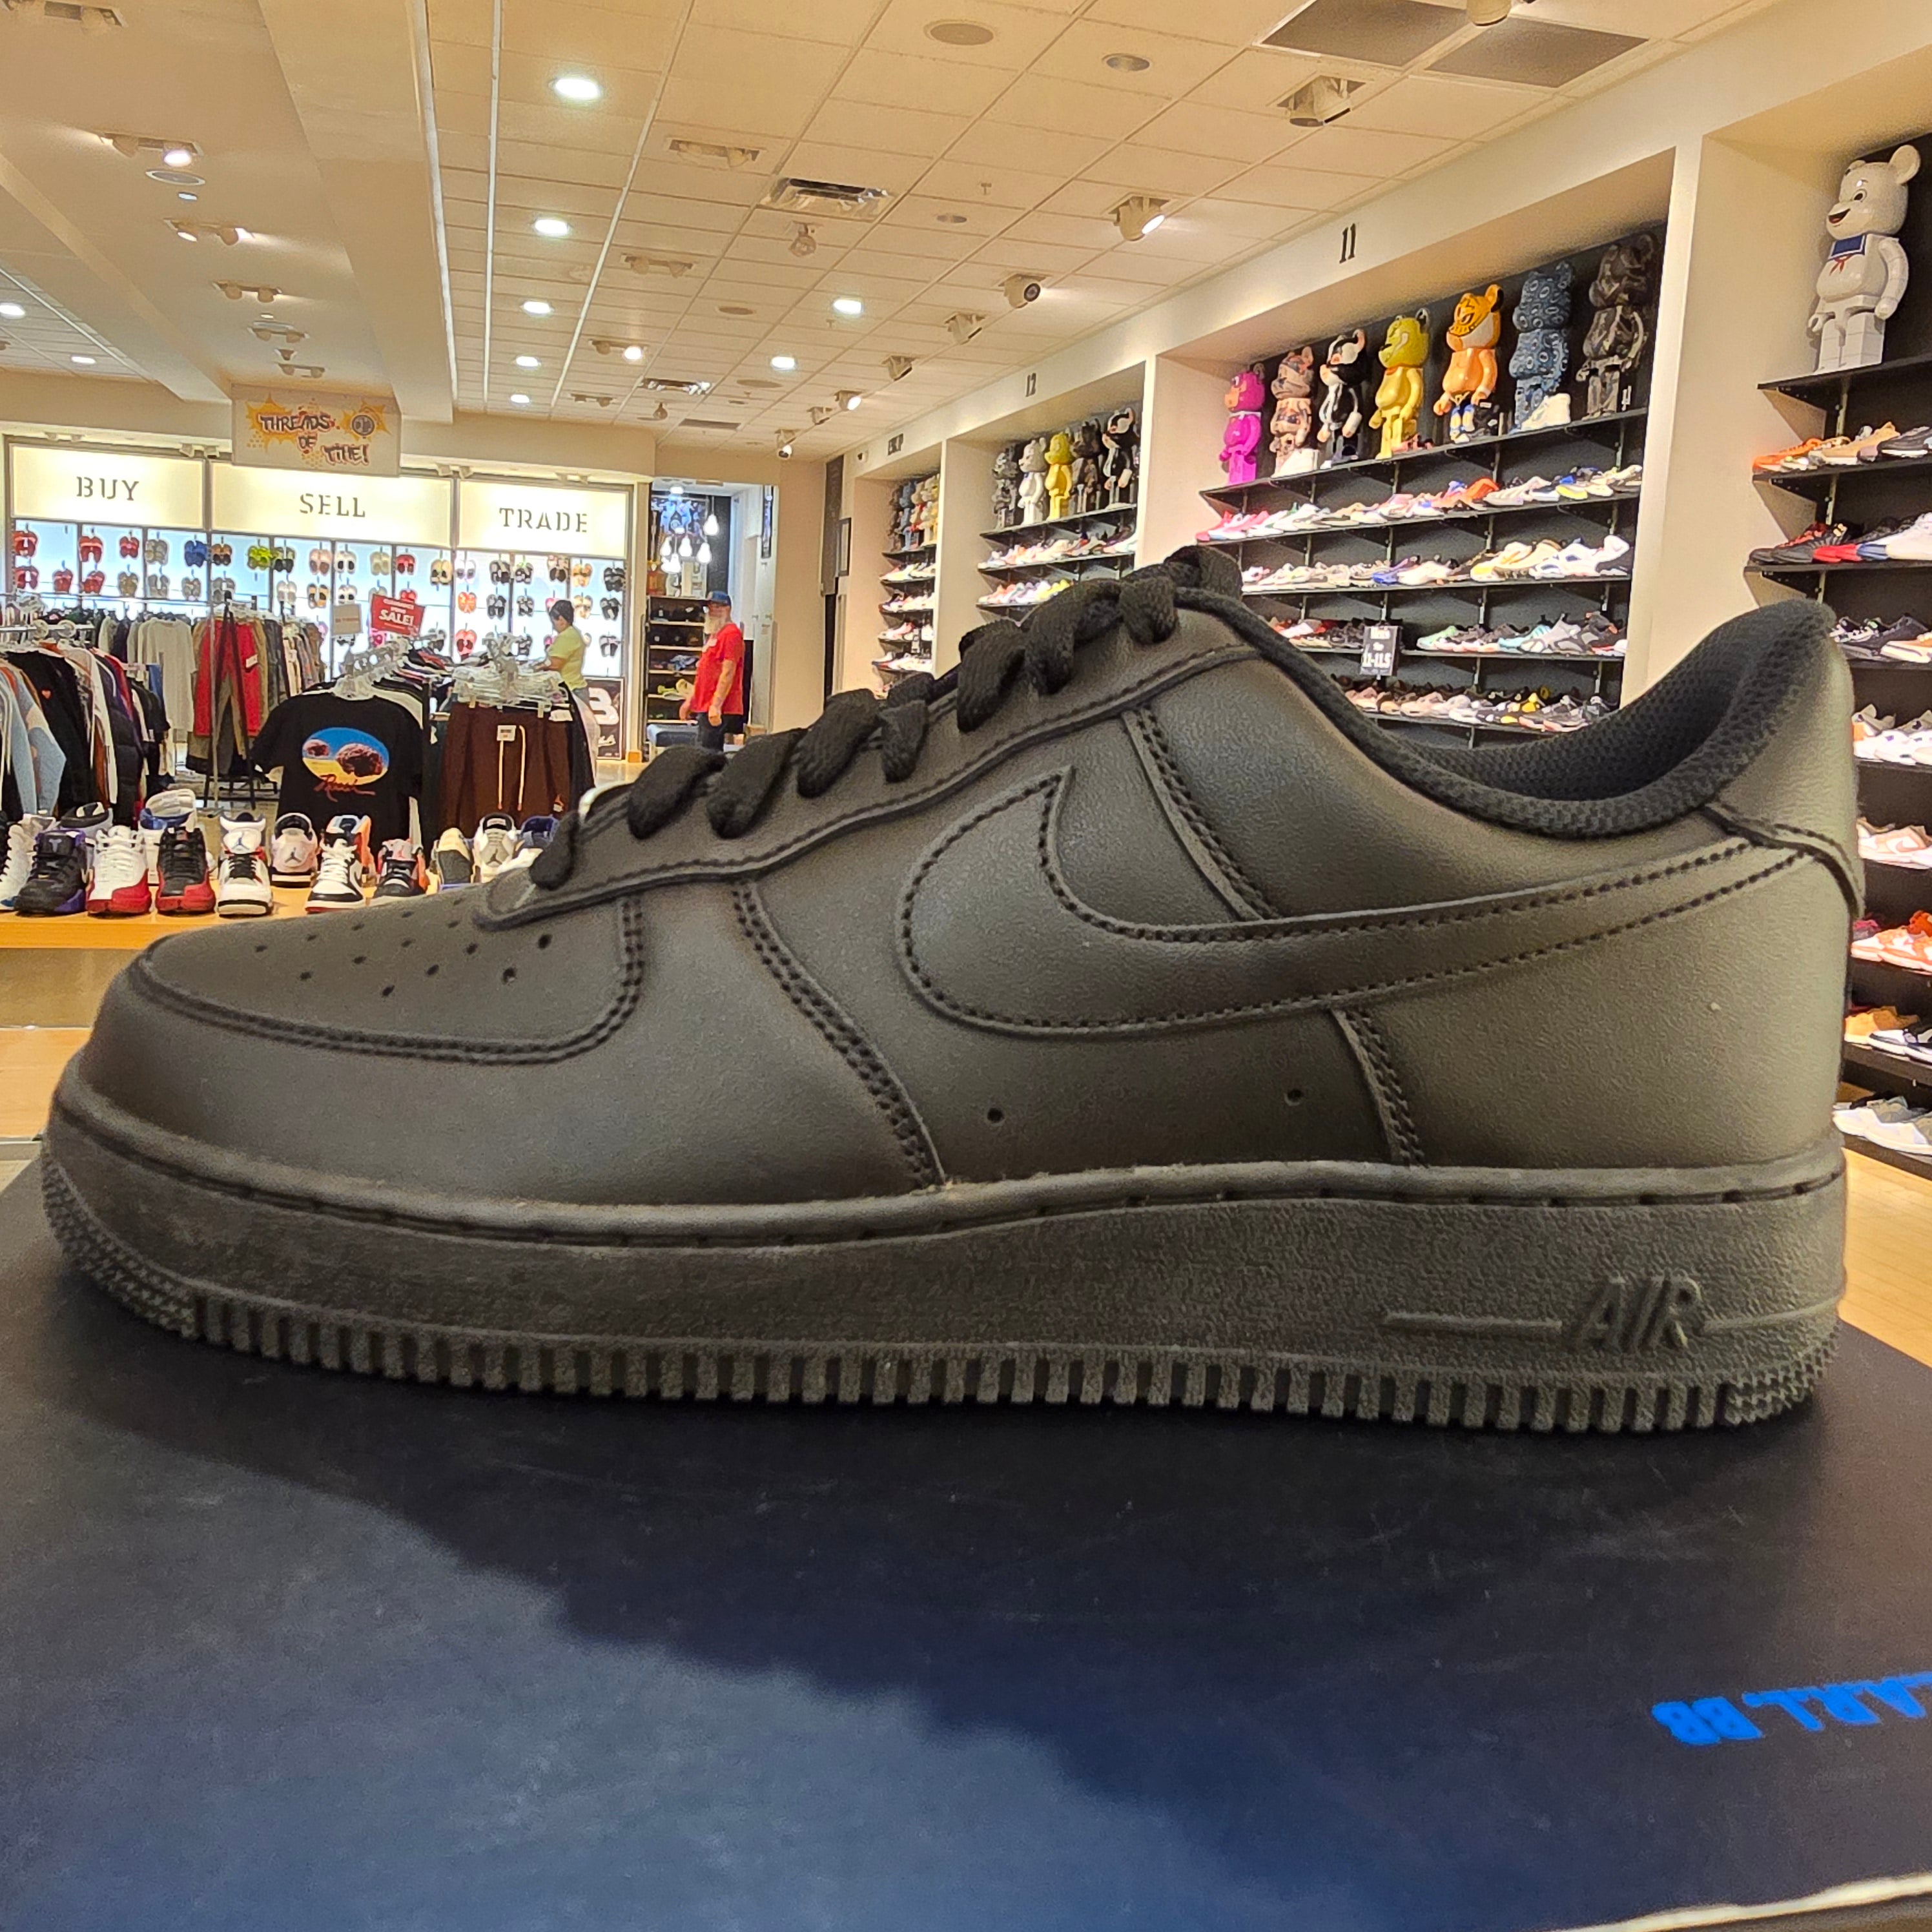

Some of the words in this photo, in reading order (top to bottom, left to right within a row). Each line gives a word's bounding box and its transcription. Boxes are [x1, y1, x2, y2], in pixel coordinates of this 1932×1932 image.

[1339, 223, 1356, 264] 11
[260, 414, 331, 431] THREADS
[76, 476, 139, 501] BUY
[300, 493, 365, 518] SELL
[499, 507, 587, 533] TRADE
[378, 609, 414, 626] SALE!
[1572, 1270, 1701, 1355] AIR
